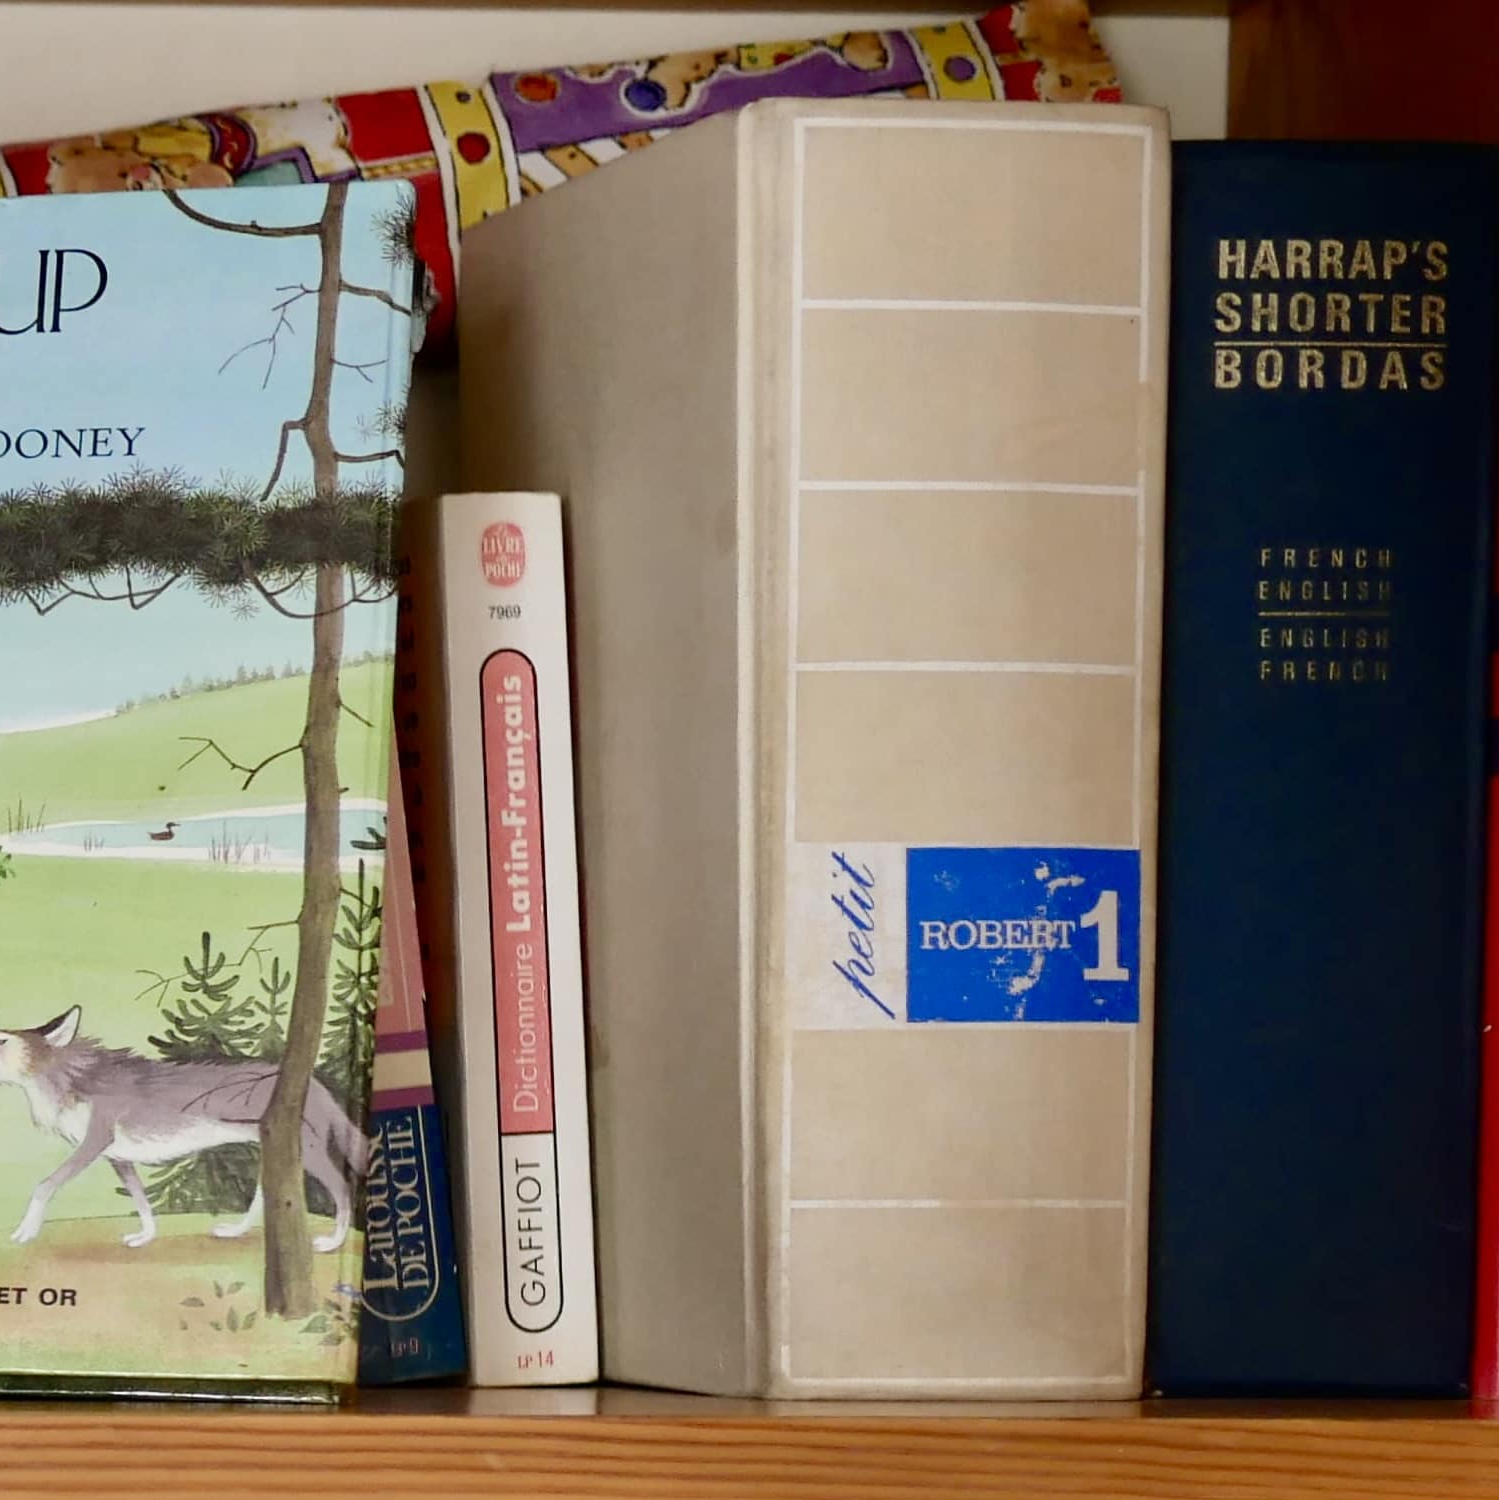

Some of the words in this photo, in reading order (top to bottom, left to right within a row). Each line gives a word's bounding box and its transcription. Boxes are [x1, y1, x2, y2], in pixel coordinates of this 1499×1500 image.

[1218, 239, 1450, 281] HARRAP'S
[1214, 292, 1448, 335] SHORTER
[1213, 348, 1446, 391] BORDAS
[1260, 547, 1391, 569] FRENCH
[1258, 580, 1390, 601] ENGLISH
[1259, 628, 1389, 649] ENGLISH
[1259, 660, 1388, 681] FRENCH
[497, 673, 533, 934] Latin-Français
[830, 852, 897, 1020] petit
[919, 920, 1076, 952] ROBERT
[1081, 890, 1130, 983] 1
[509, 942, 541, 1114] Dictionnaire
[387, 1115, 424, 1237] POCHE
[514, 1157, 547, 1308] GAFFIOT
[400, 1240, 430, 1291] DE
[38, 1286, 78, 1307] OR
[516, 1351, 534, 1370] LP
[536, 1349, 555, 1368] 14
